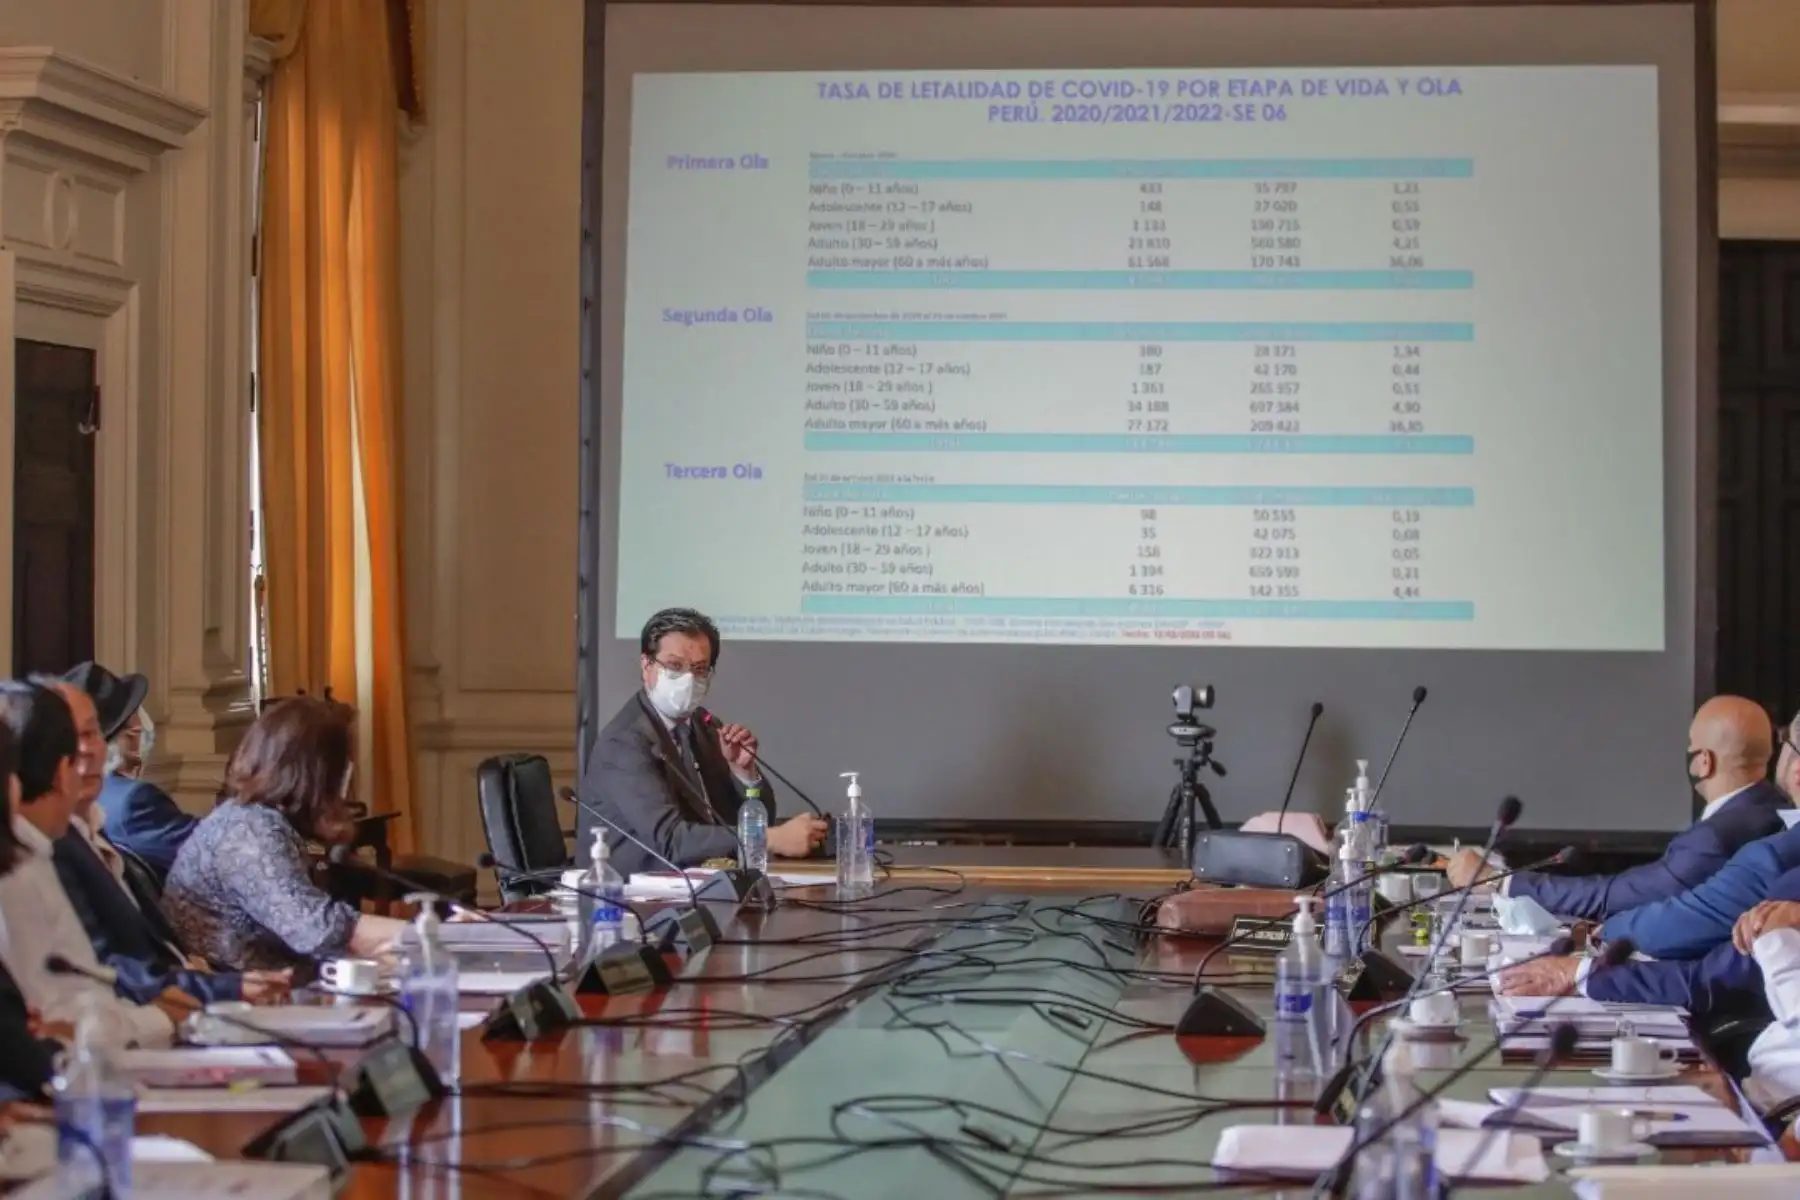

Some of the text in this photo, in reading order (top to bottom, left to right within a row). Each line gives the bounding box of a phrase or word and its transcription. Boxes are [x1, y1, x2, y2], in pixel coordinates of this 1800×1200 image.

[818, 79, 1462, 99] TASA DE LETALIDAD DE COVID-19 POR ETAPA DE VIDA Y OLA
[1262, 104, 1286, 121] 06
[667, 152, 769, 169] Primera Ola
[662, 307, 773, 326] Segunda Ola
[884, 344, 917, 358] años)
[805, 362, 880, 374] Adolescente
[937, 362, 970, 376] años)
[806, 381, 840, 392] Joven
[896, 380, 924, 393] años
[805, 399, 846, 411] Adulto
[902, 398, 935, 413] años)
[805, 417, 845, 430] Adulto
[849, 420, 886, 433] mayor
[914, 420, 920, 430] a
[925, 419, 948, 430] más
[953, 418, 986, 432] años)
[664, 463, 763, 479] Tercera Ola
[881, 505, 914, 520] años)
[802, 524, 878, 536] Adolescente
[935, 525, 968, 538] años)
[1140, 526, 1156, 540] 35
[802, 543, 836, 555] Joven
[894, 543, 922, 556] años
[802, 561, 842, 574] Adulto
[900, 563, 933, 577] años)
[1129, 564, 1136, 578] 1
[802, 580, 842, 592] Adulto
[846, 582, 884, 595] mayor
[912, 582, 918, 593] a
[923, 582, 946, 593] más
[952, 582, 984, 595] años)
[1129, 584, 1137, 597] 6
